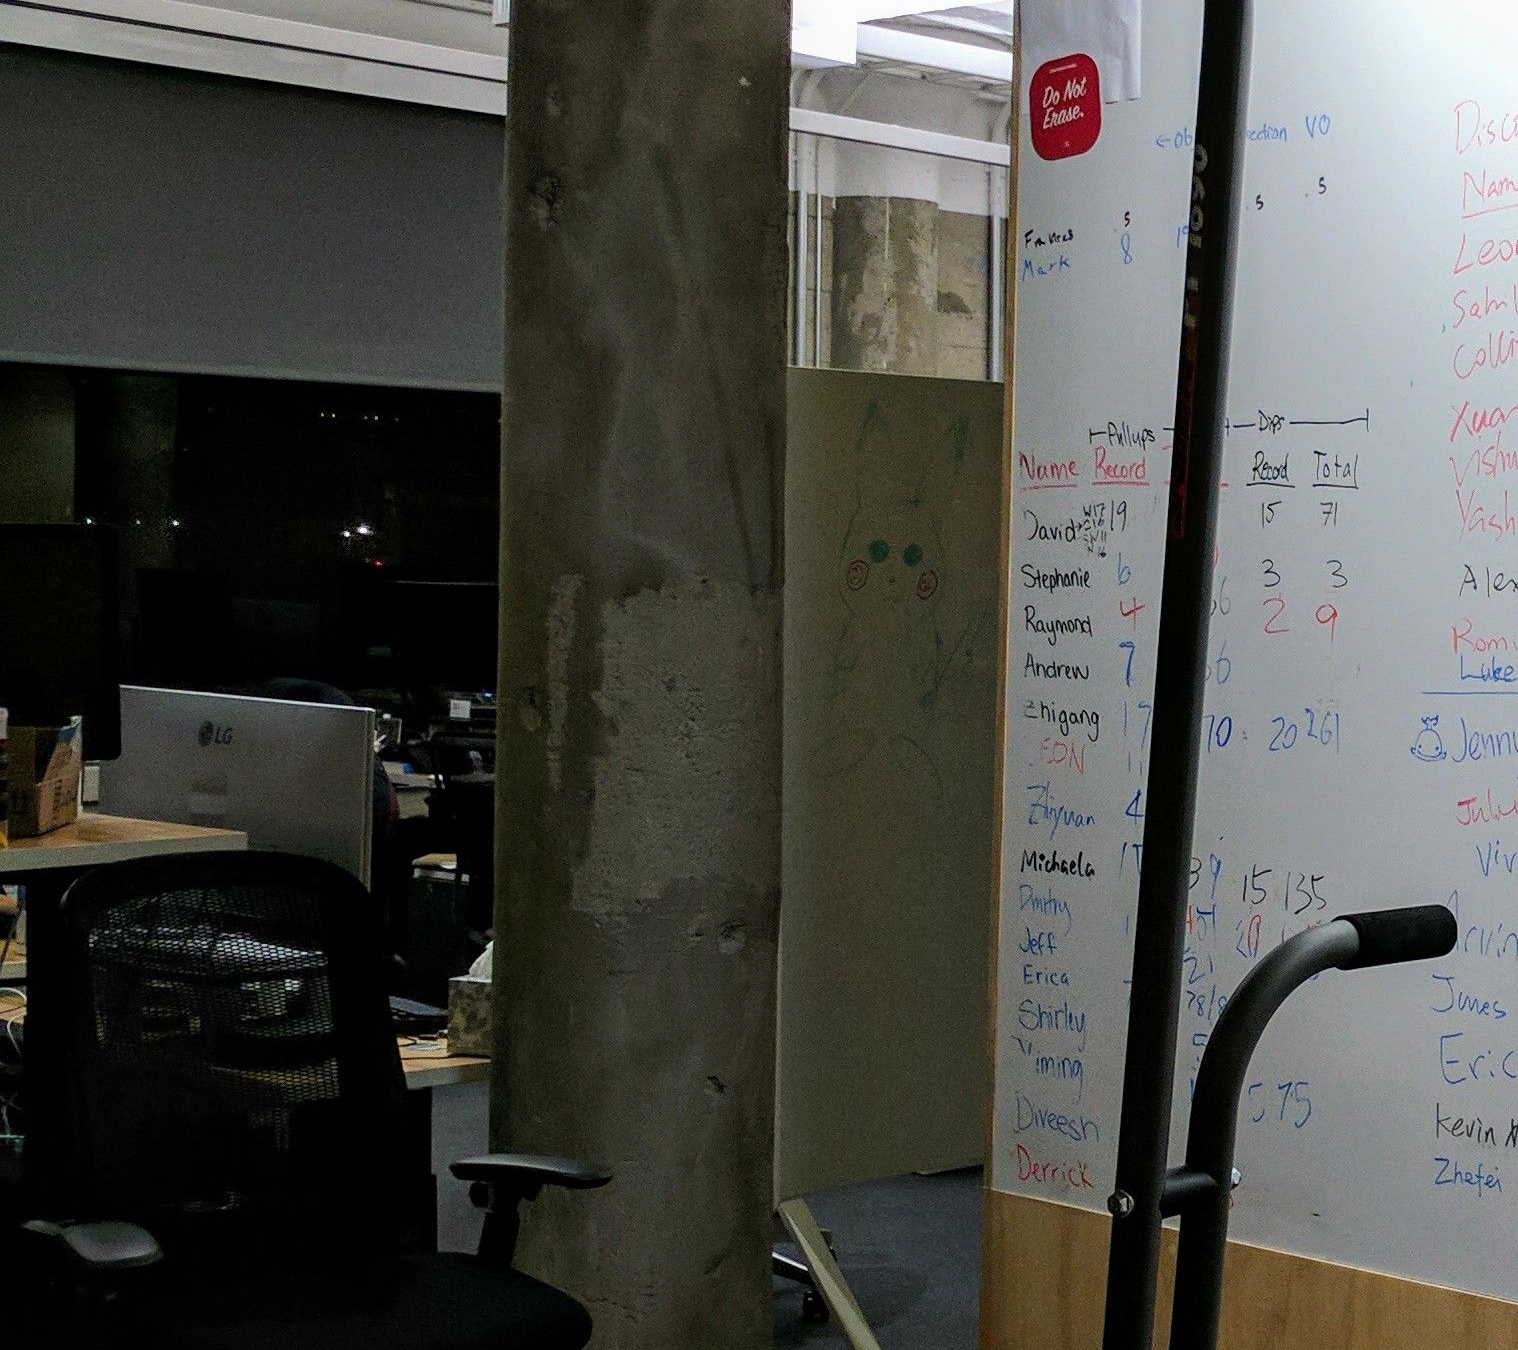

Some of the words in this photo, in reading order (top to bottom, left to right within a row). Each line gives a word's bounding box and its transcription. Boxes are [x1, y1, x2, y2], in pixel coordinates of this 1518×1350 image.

[1042, 84, 1060, 108] Do
[1062, 76, 1087, 101] Not
[1042, 101, 1085, 130] Erase.
[1019, 451, 1080, 481] Name
[1094, 445, 1147, 480] Record
[1252, 451, 1290, 482] Record
[1313, 451, 1359, 488] Total
[1020, 563, 1091, 599] Stephanie
[1261, 558, 1282, 588] 3
[1326, 559, 1348, 589] 3
[1024, 604, 1093, 647] Raymond
[1119, 597, 1146, 632] 4
[1262, 596, 1290, 634] 2
[1315, 603, 1339, 645] 9
[1024, 651, 1091, 681] Andrew
[1118, 640, 1136, 688] 7
[213, 725, 233, 745] LG
[1268, 715, 1298, 752] 20
[1020, 848, 1096, 878] Michaela
[1242, 863, 1273, 905] 15
[1284, 871, 1327, 916] 135
[1022, 963, 1071, 987] Erica
[1016, 1143, 1094, 1188] Derrick
